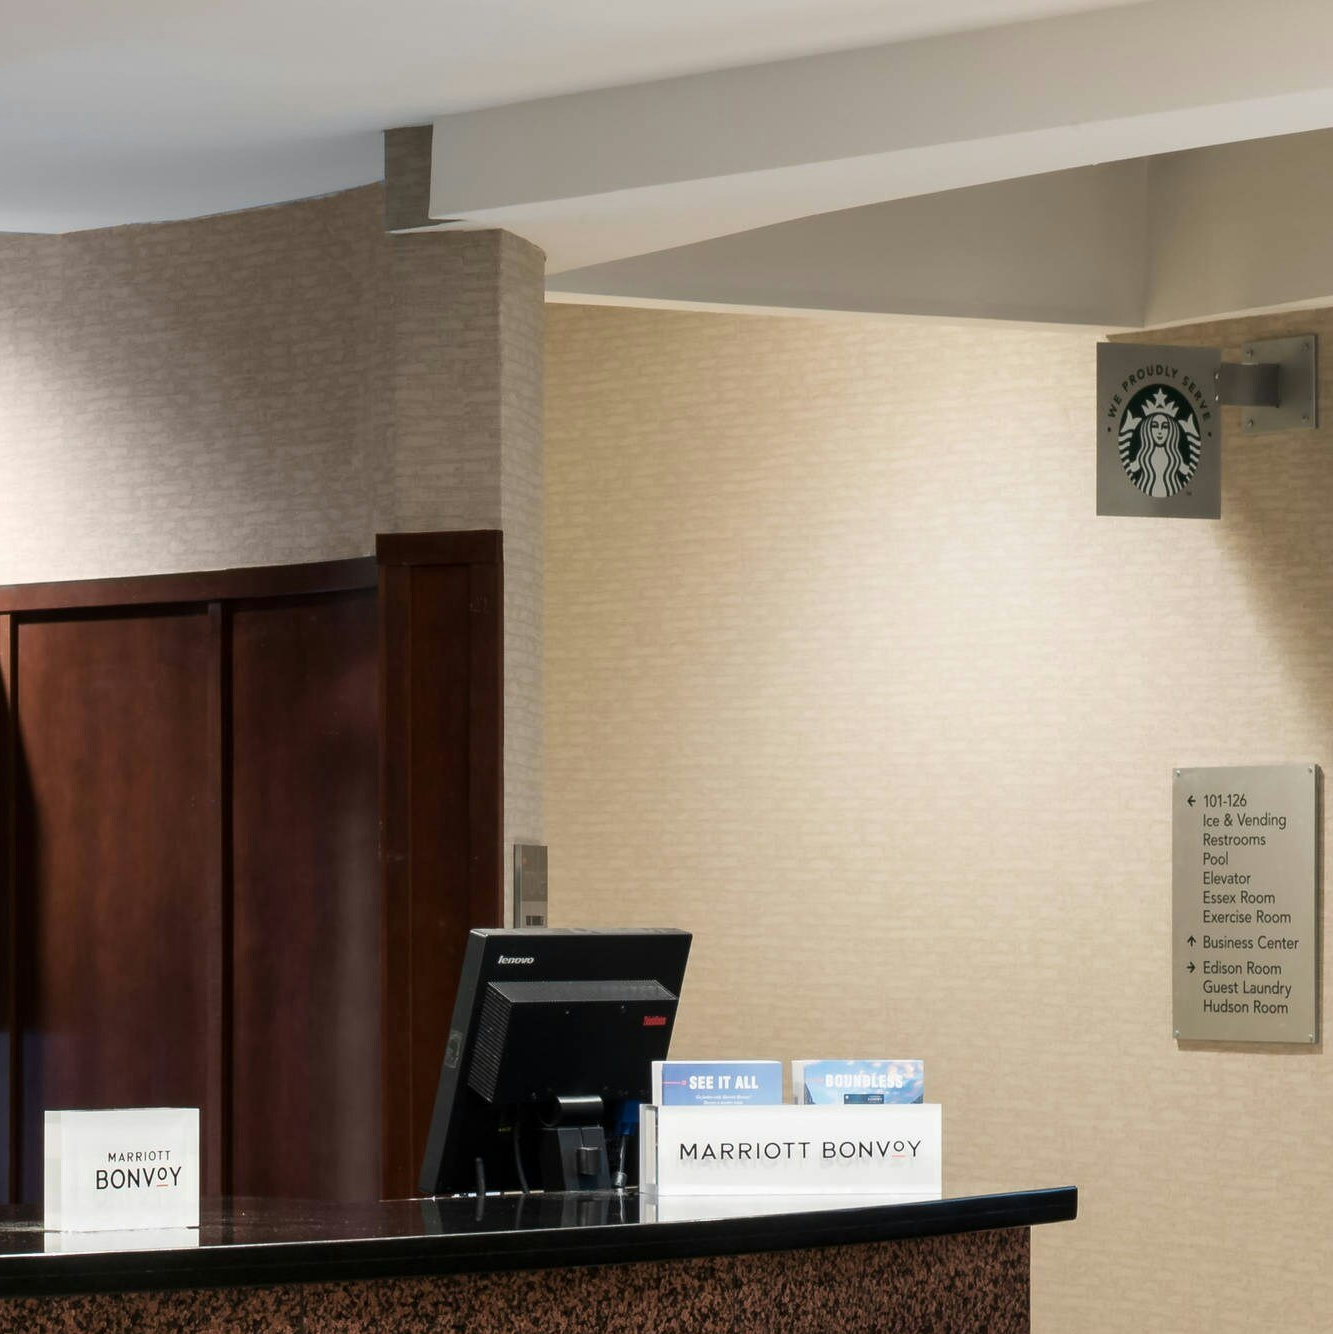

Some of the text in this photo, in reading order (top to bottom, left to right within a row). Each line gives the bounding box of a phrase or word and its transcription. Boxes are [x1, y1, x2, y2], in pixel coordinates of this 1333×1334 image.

[1107, 363, 1212, 420] WE PROUDLY SERVE
[1203, 793, 1247, 808] 101-126
[1202, 811, 1287, 830] Ice & Vending
[1202, 832, 1267, 847] Restrooms
[1202, 851, 1229, 866] Pool
[1202, 870, 1252, 885] Elevator
[1202, 890, 1276, 905] Essex Room
[1202, 909, 1292, 924] Exercise Room
[1202, 935, 1300, 950] Business Center
[497, 955, 535, 965] lenovo
[1202, 960, 1282, 976] Edison Room
[1202, 979, 1292, 999] Guest Laundry
[1202, 998, 1289, 1015] Hudson Room
[689, 1075, 759, 1090] SEE IT ALL
[107, 1150, 171, 1162] MARRIOTT
[679, 1142, 812, 1161] MARRIOTT
